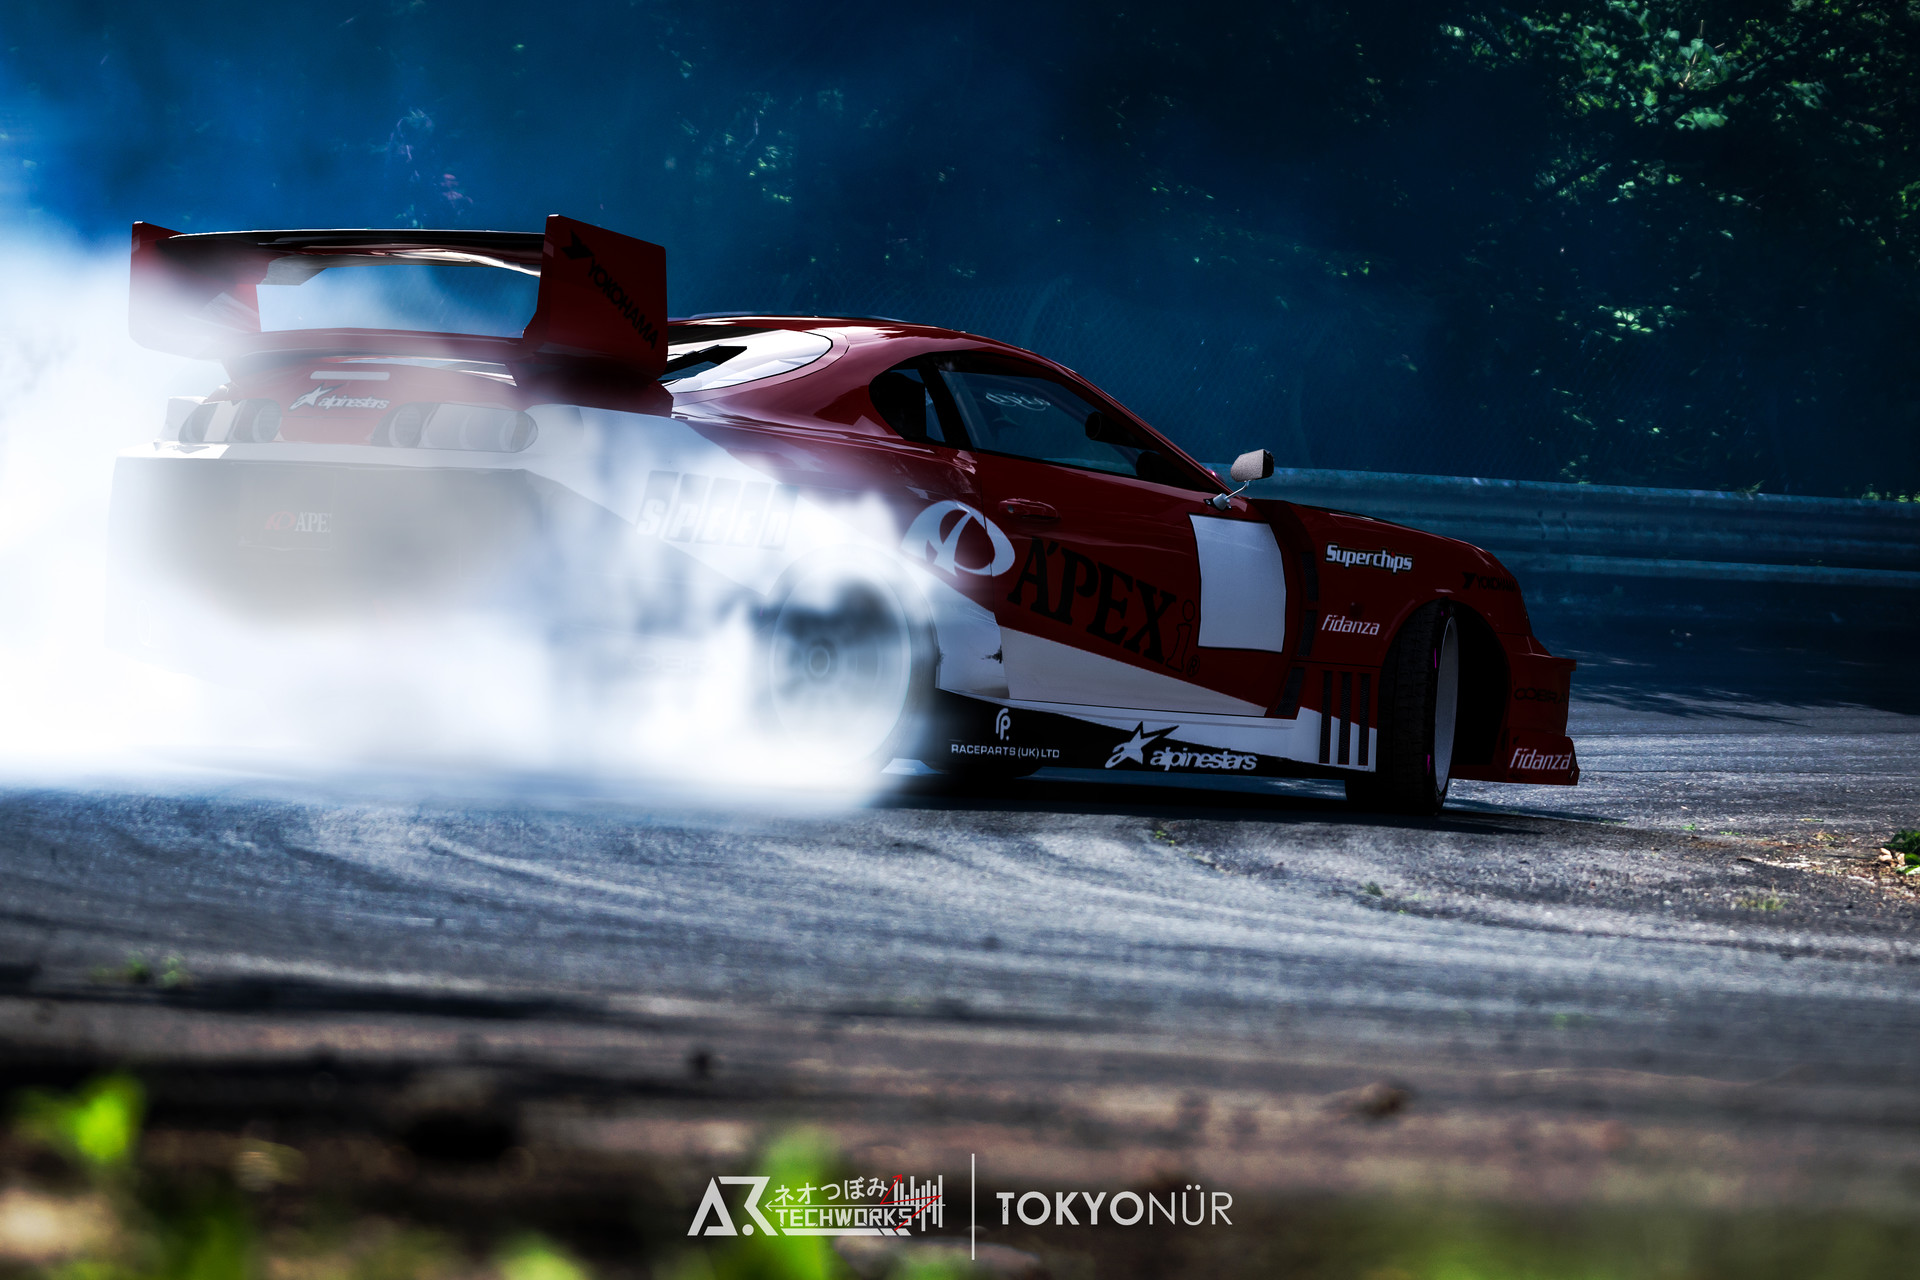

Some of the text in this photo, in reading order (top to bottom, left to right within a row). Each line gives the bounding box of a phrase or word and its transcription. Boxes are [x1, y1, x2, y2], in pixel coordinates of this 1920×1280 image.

[588, 259, 659, 349] YOKOHAMA
[317, 394, 390, 411] alpinestars
[1325, 543, 1414, 574] Superchips
[1321, 613, 1381, 637] fidanza
[951, 743, 1016, 757] RACEPARTS
[1040, 748, 1060, 759] LTD
[1150, 746, 1258, 772] alpinestars
[1509, 747, 1571, 771] fidanza
